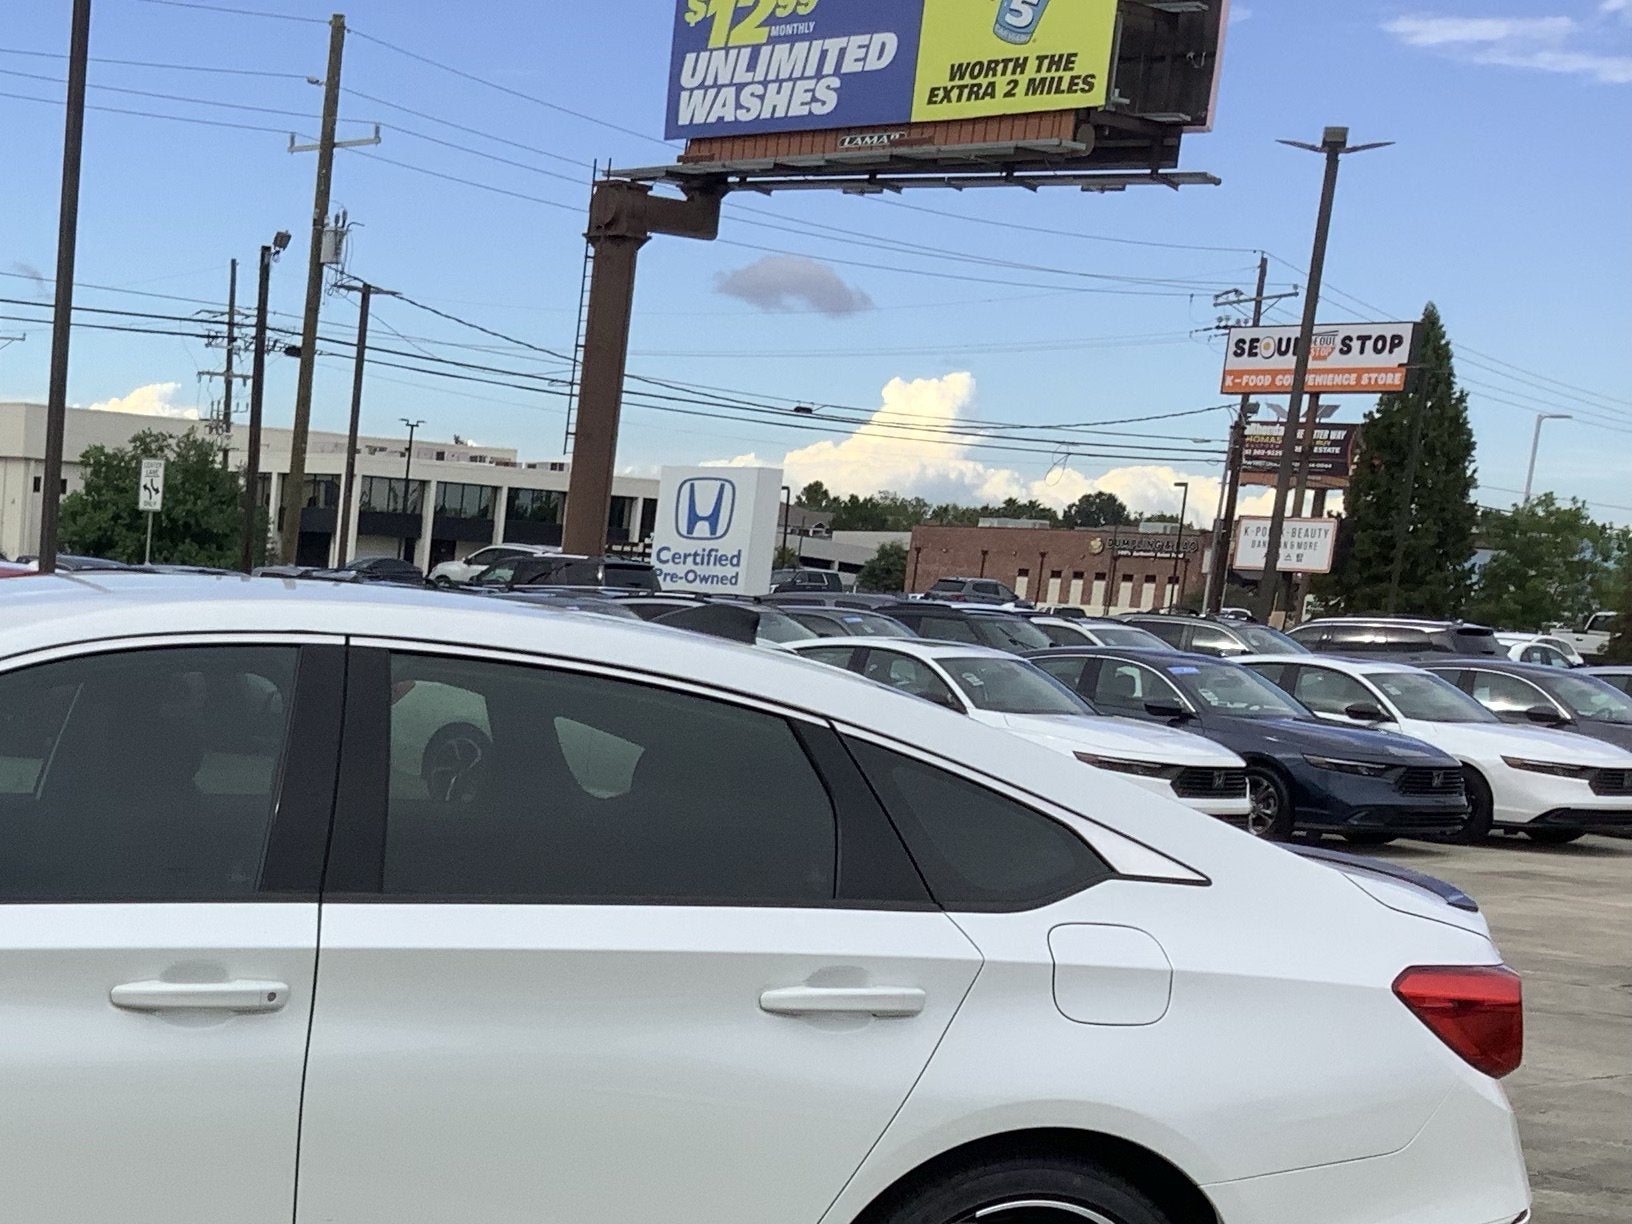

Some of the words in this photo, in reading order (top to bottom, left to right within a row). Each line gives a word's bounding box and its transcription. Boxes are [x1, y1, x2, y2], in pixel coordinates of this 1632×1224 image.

[770, 21, 816, 37] MONTHLY
[679, 32, 899, 88] UNLIMITED
[948, 56, 1029, 82] WORTH
[1035, 52, 1079, 74] THE
[926, 81, 997, 105] EXTRA
[1003, 79, 1020, 98] 2
[1024, 74, 1097, 97] MILES
[678, 76, 841, 126] WASHES
[1339, 334, 1404, 356] STOP
[1225, 374, 1272, 386] K-FOOD
[1275, 373, 1357, 386] COENIENCE
[1361, 372, 1402, 385] STORE
[1243, 526, 1268, 537] K-PO
[656, 546, 742, 567] Certified
[1296, 541, 1318, 551] MORE
[654, 568, 739, 586] Pre-Owned
